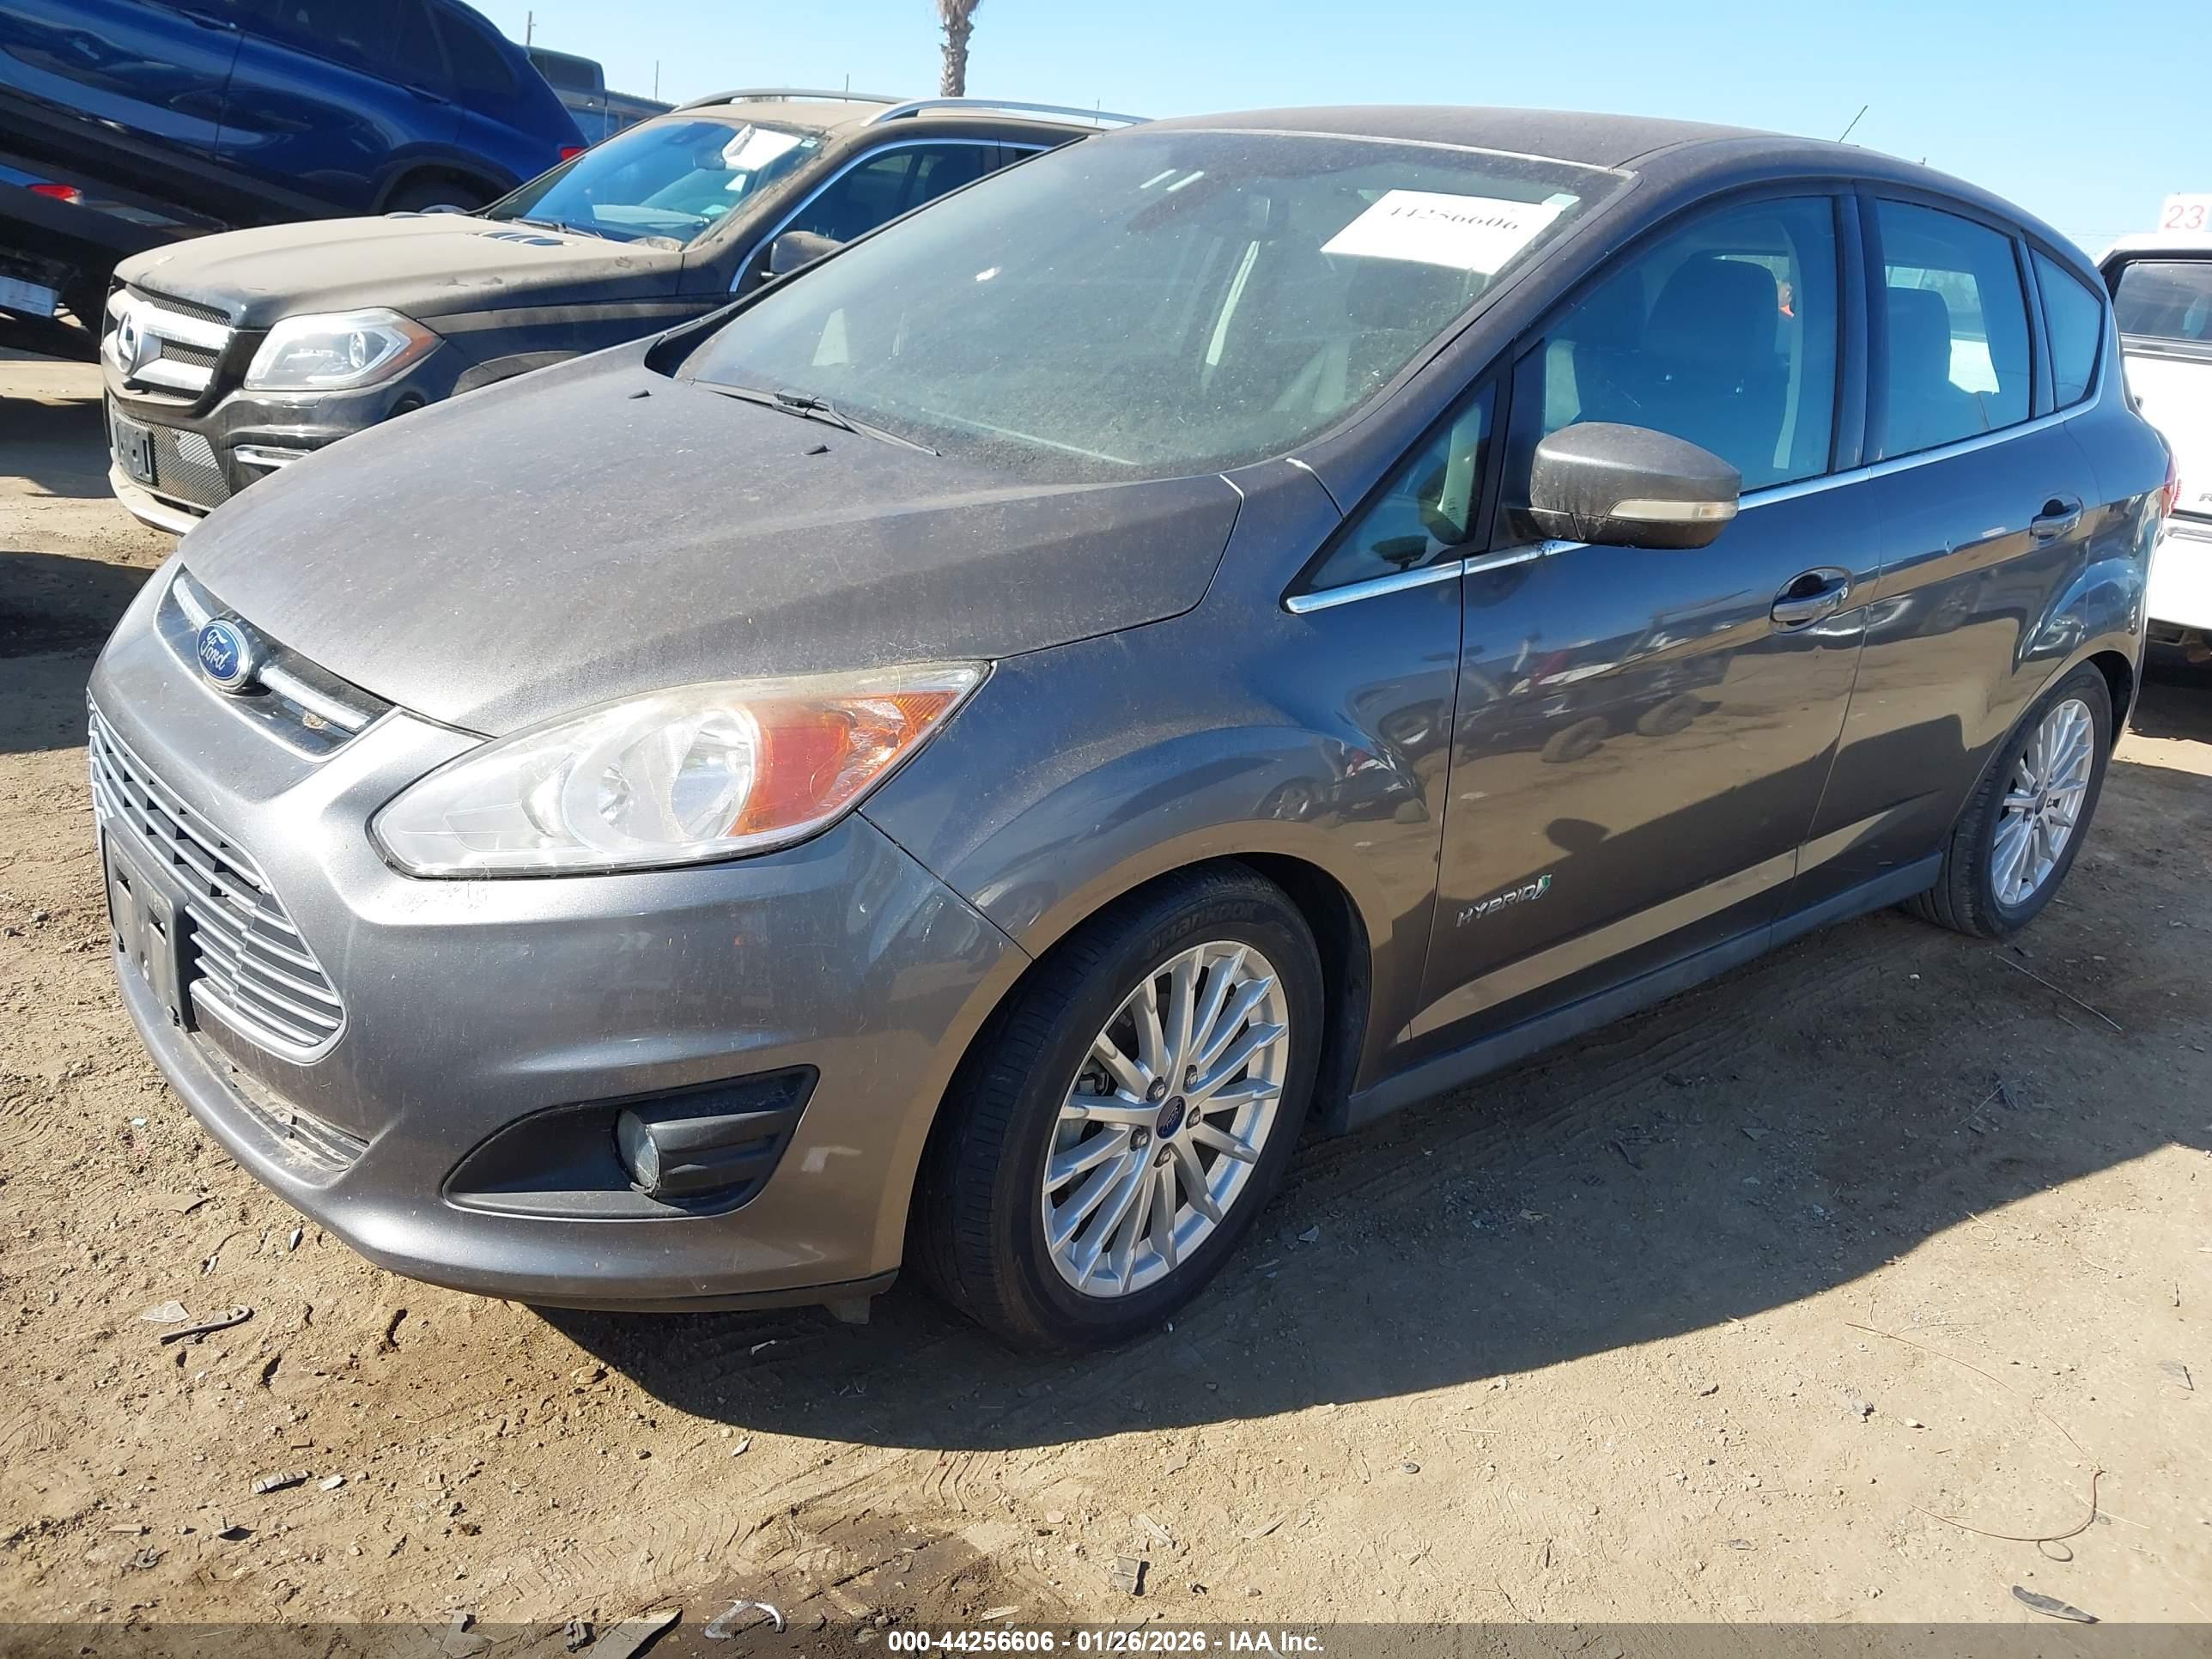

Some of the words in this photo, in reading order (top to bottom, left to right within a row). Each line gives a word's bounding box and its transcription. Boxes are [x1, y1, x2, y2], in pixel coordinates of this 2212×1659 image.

[2163, 204, 2205, 229] 23
[200, 629, 231, 672] Ford
[1455, 884, 1537, 927] HYBRID
